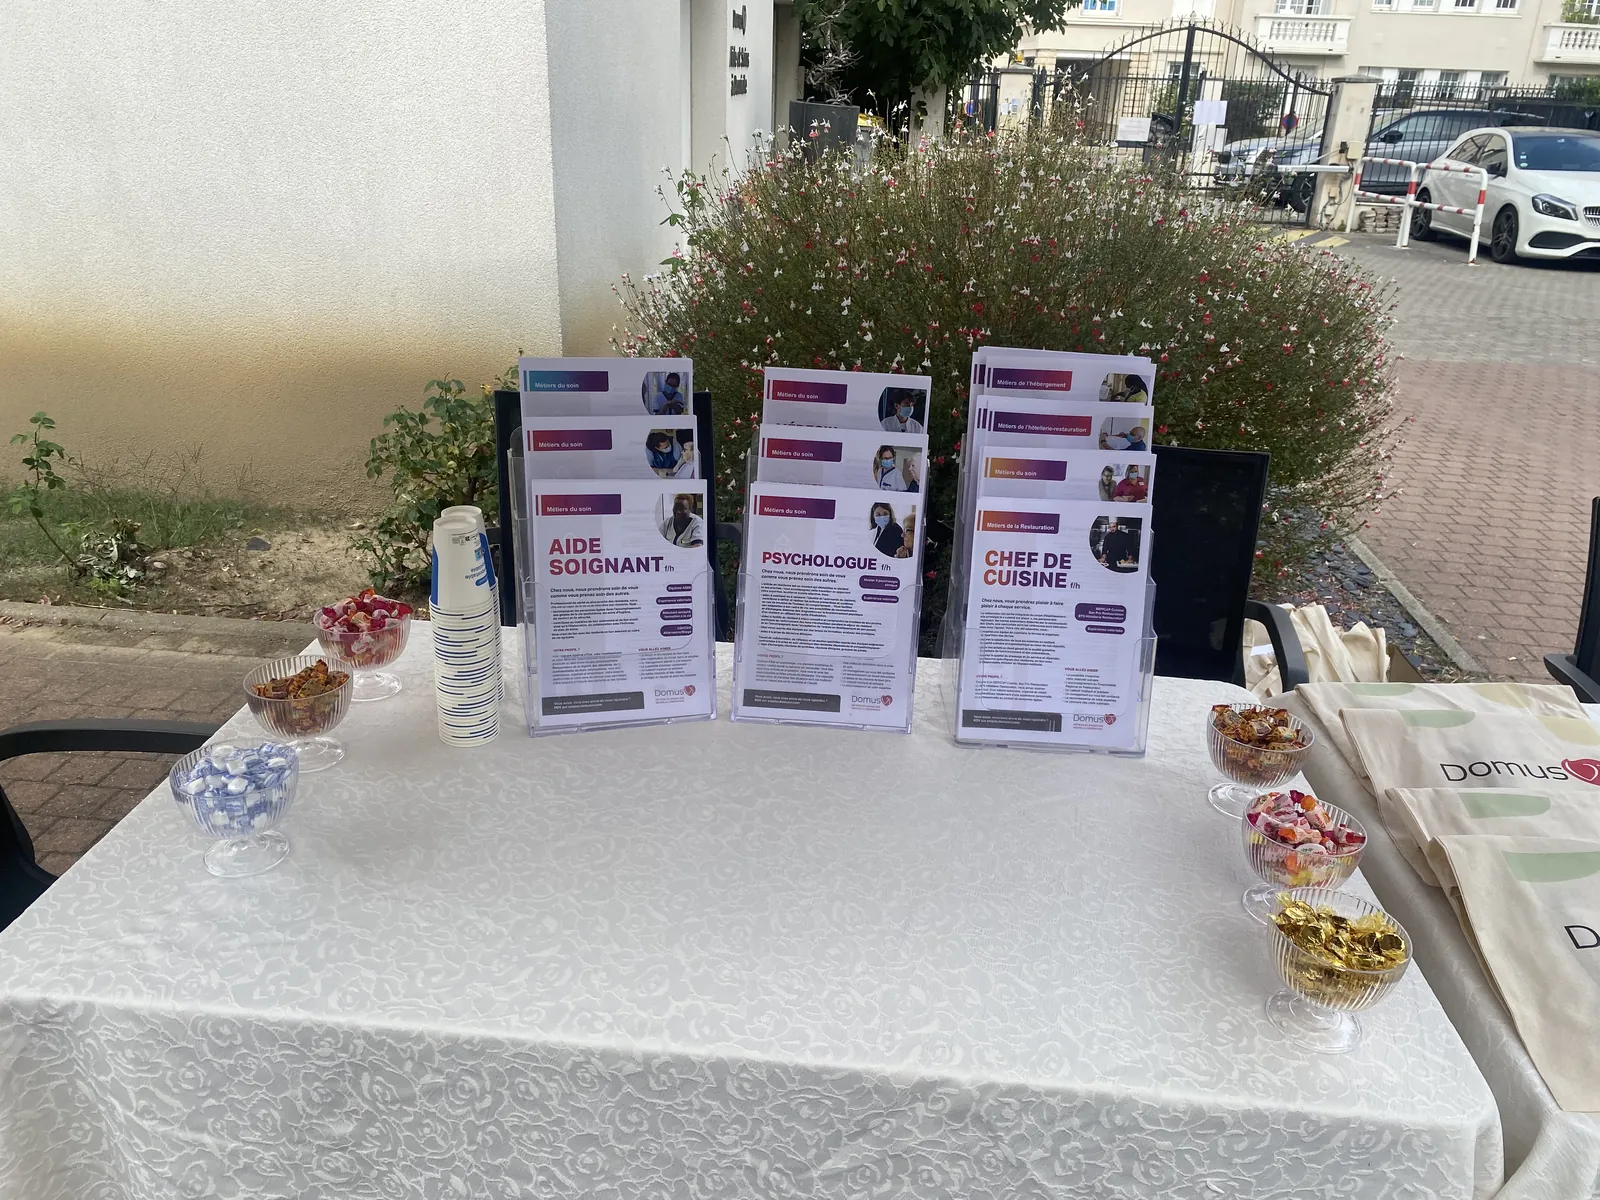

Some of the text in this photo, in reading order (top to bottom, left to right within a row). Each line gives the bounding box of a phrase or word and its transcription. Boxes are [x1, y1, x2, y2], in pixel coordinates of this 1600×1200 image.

[549, 538, 601, 555] AIDE
[550, 556, 664, 575] SOIGNANT
[762, 552, 877, 570] PSYCHOLOGUE
[985, 550, 1072, 569] CHEF DE
[984, 569, 1067, 588] CUISINE
[852, 696, 881, 704] Domus
[1073, 714, 1104, 723] Domus
